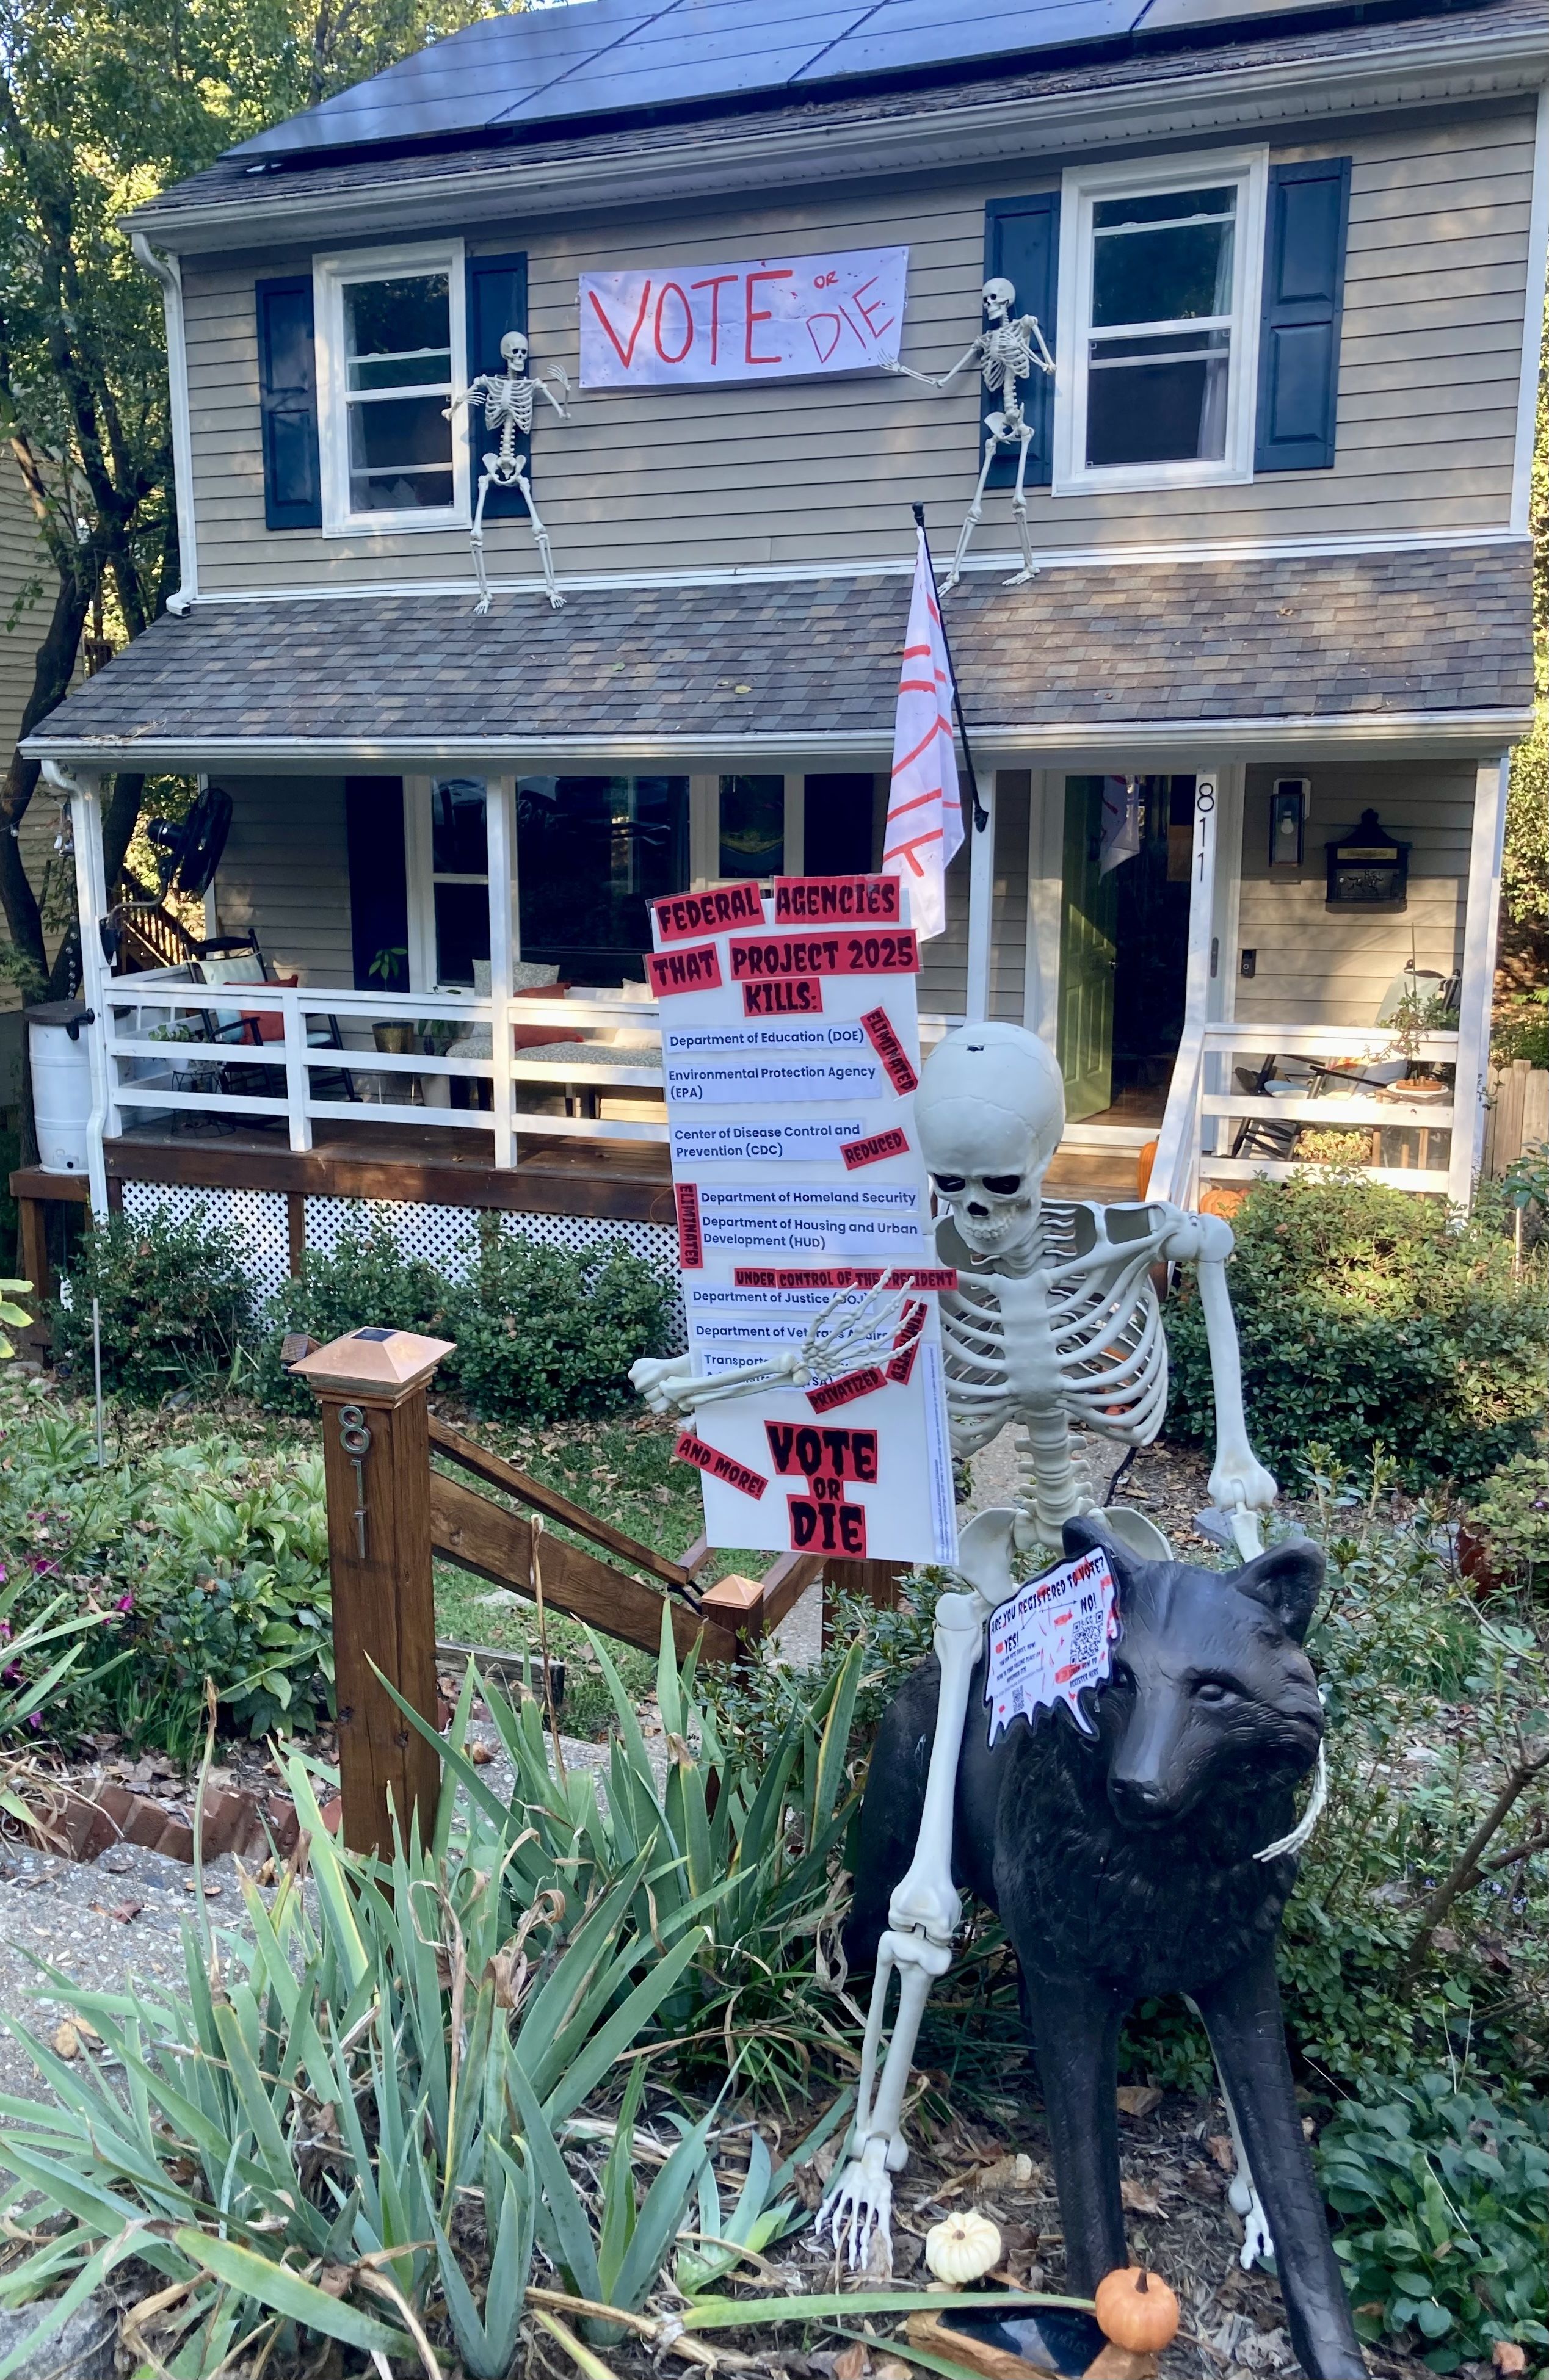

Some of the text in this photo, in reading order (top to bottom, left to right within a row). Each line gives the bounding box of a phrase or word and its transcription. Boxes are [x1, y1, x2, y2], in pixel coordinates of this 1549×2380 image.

[589, 269, 838, 369] VOTE OR
[806, 276, 895, 364] DIE
[1197, 783, 1214, 882] 811
[655, 883, 895, 935] FEDERAL AGENCIES
[653, 935, 913, 986] THAT PROJECT 2025
[745, 982, 818, 1013] KILLS:
[670, 1028, 864, 1048] Department of Education (DOE)
[866, 1010, 916, 1090] ELIMINATED
[669, 1066, 876, 1080] Environmental Protection Agency
[670, 1085, 703, 1099] (EPA)
[675, 1124, 860, 1140] Center of Disease Control and
[676, 1142, 783, 1157] Prevention (CDC)
[844, 1132, 902, 1164] REDUCED
[702, 1192, 916, 1206] Department of Homeland Security
[680, 1185, 698, 1266] ELIMINATED
[702, 1217, 918, 1234] Department of Housing and Urban
[704, 1233, 825, 1250] Development (HUD)
[736, 1271, 953, 1287] UNDER CONTROL OF THE REIDENT
[692, 1291, 767, 1303] Department
[770, 1292, 782, 1302] of
[785, 1293, 830, 1303] Justice
[696, 1325, 771, 1338] Department
[773, 1326, 785, 1337] of
[787, 1327, 844, 1339] Vetras
[809, 1370, 879, 1409] PRIVATIZED
[678, 1438, 763, 1497] AND MORE!
[767, 1425, 876, 1481] VOTE
[338, 1406, 371, 1558] 811
[813, 1477, 840, 1501] OR
[791, 1501, 862, 1553] DIE
[991, 1556, 1105, 1635] ARE YOU REGISTERED TO VOTE?
[1080, 1592, 1097, 1616] NO!
[1004, 1630, 1020, 1654] YES!
